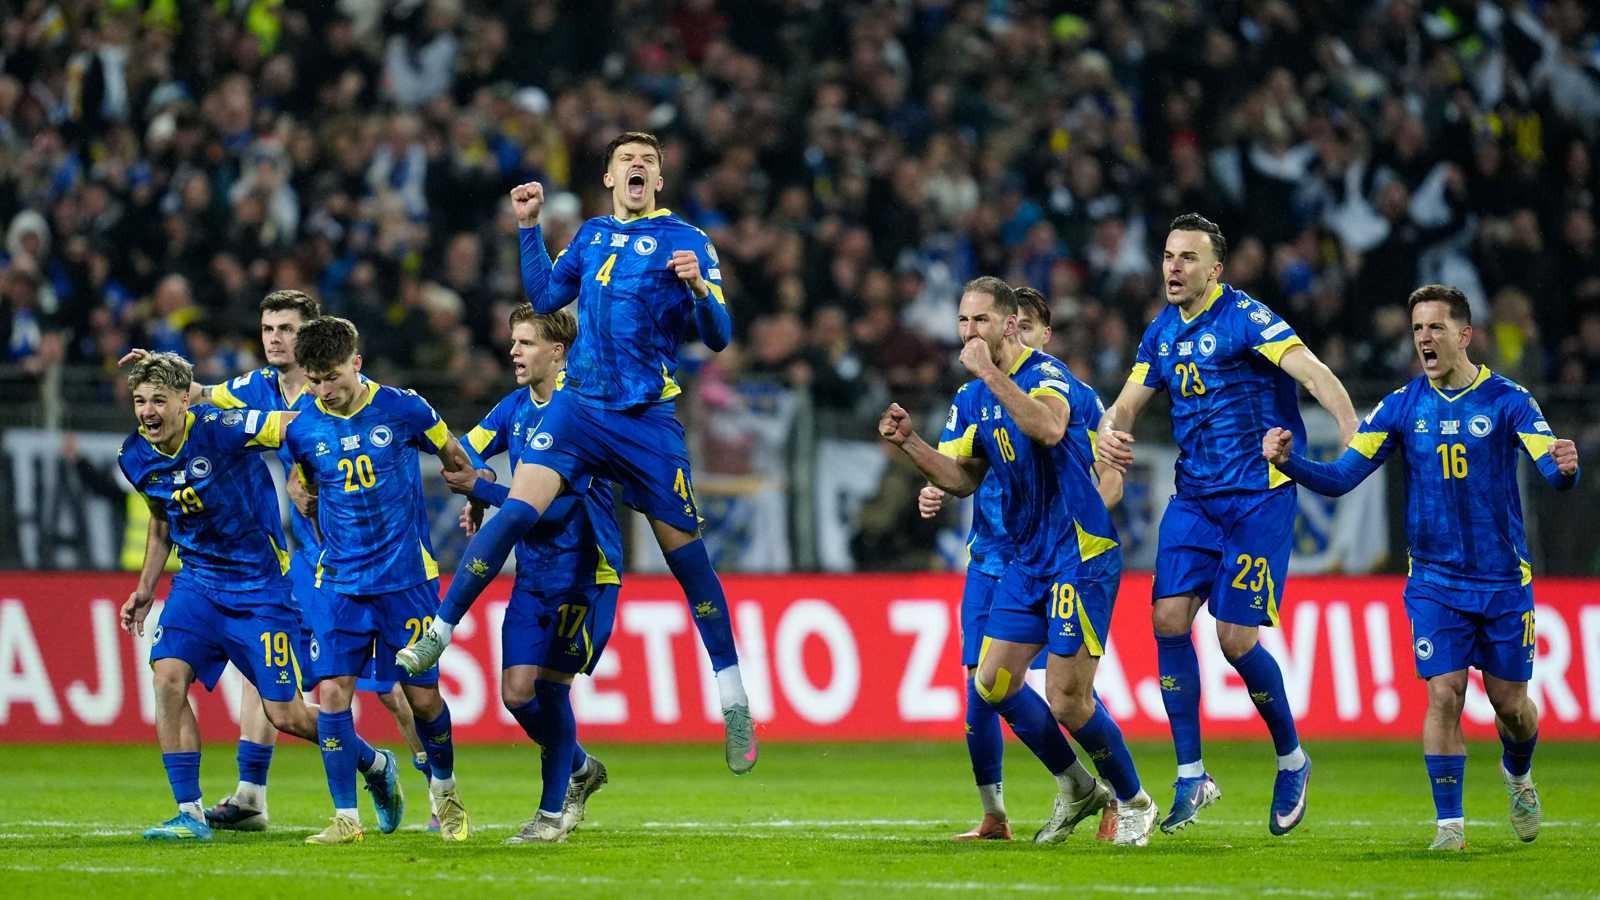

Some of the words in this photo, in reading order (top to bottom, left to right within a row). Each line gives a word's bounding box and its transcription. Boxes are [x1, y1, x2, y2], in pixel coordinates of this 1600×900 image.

[594, 253, 617, 286] 4
[1174, 363, 1207, 397] 23
[993, 427, 1017, 463] 18
[1436, 443, 1469, 480] 16
[337, 454, 376, 493] 20
[170, 486, 205, 514] 19
[1231, 554, 1268, 592] 23
[1051, 583, 1076, 619] 18
[557, 603, 588, 639] 17
[260, 632, 290, 668] 19
[888, 599, 1401, 724] ZEVI!
